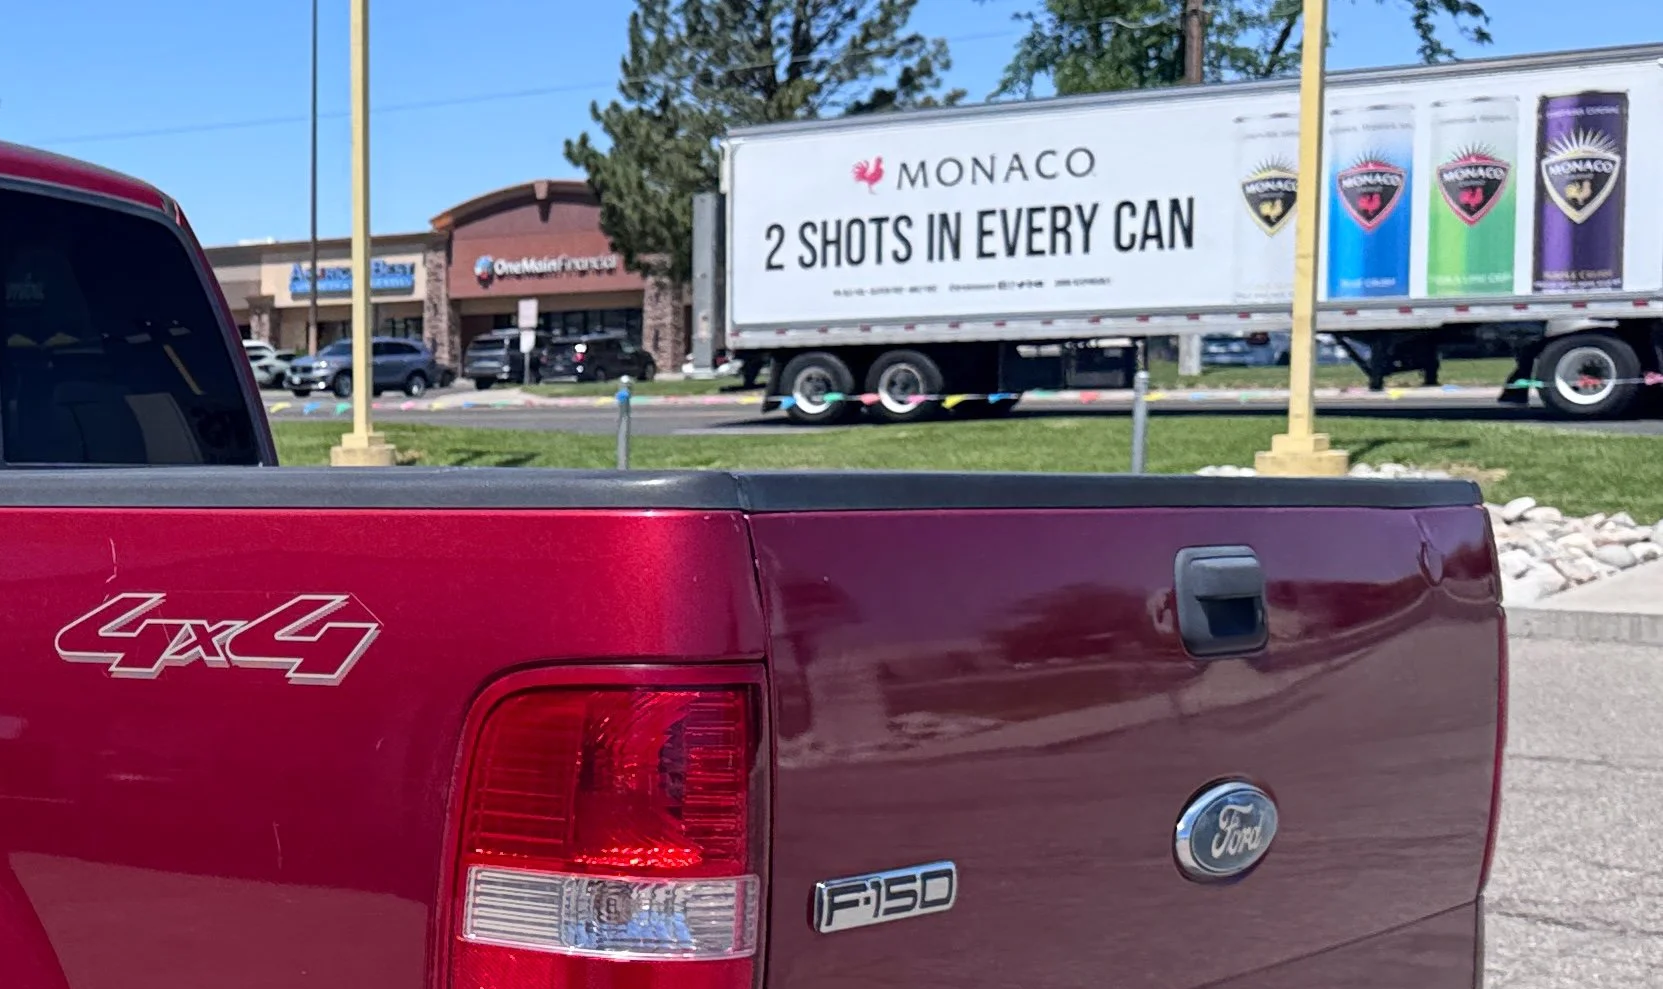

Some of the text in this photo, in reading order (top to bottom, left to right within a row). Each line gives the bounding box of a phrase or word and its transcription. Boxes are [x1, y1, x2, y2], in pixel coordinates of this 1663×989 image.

[896, 147, 1096, 191] MONACO
[1340, 172, 1403, 189] MONACO
[1442, 166, 1506, 182] MONACO
[1548, 159, 1614, 175] MONACO
[765, 196, 1195, 271] 2 SHOTS IN EVERY CAN
[54, 592, 382, 686] 4x4
[1210, 803, 1264, 859] Ford
